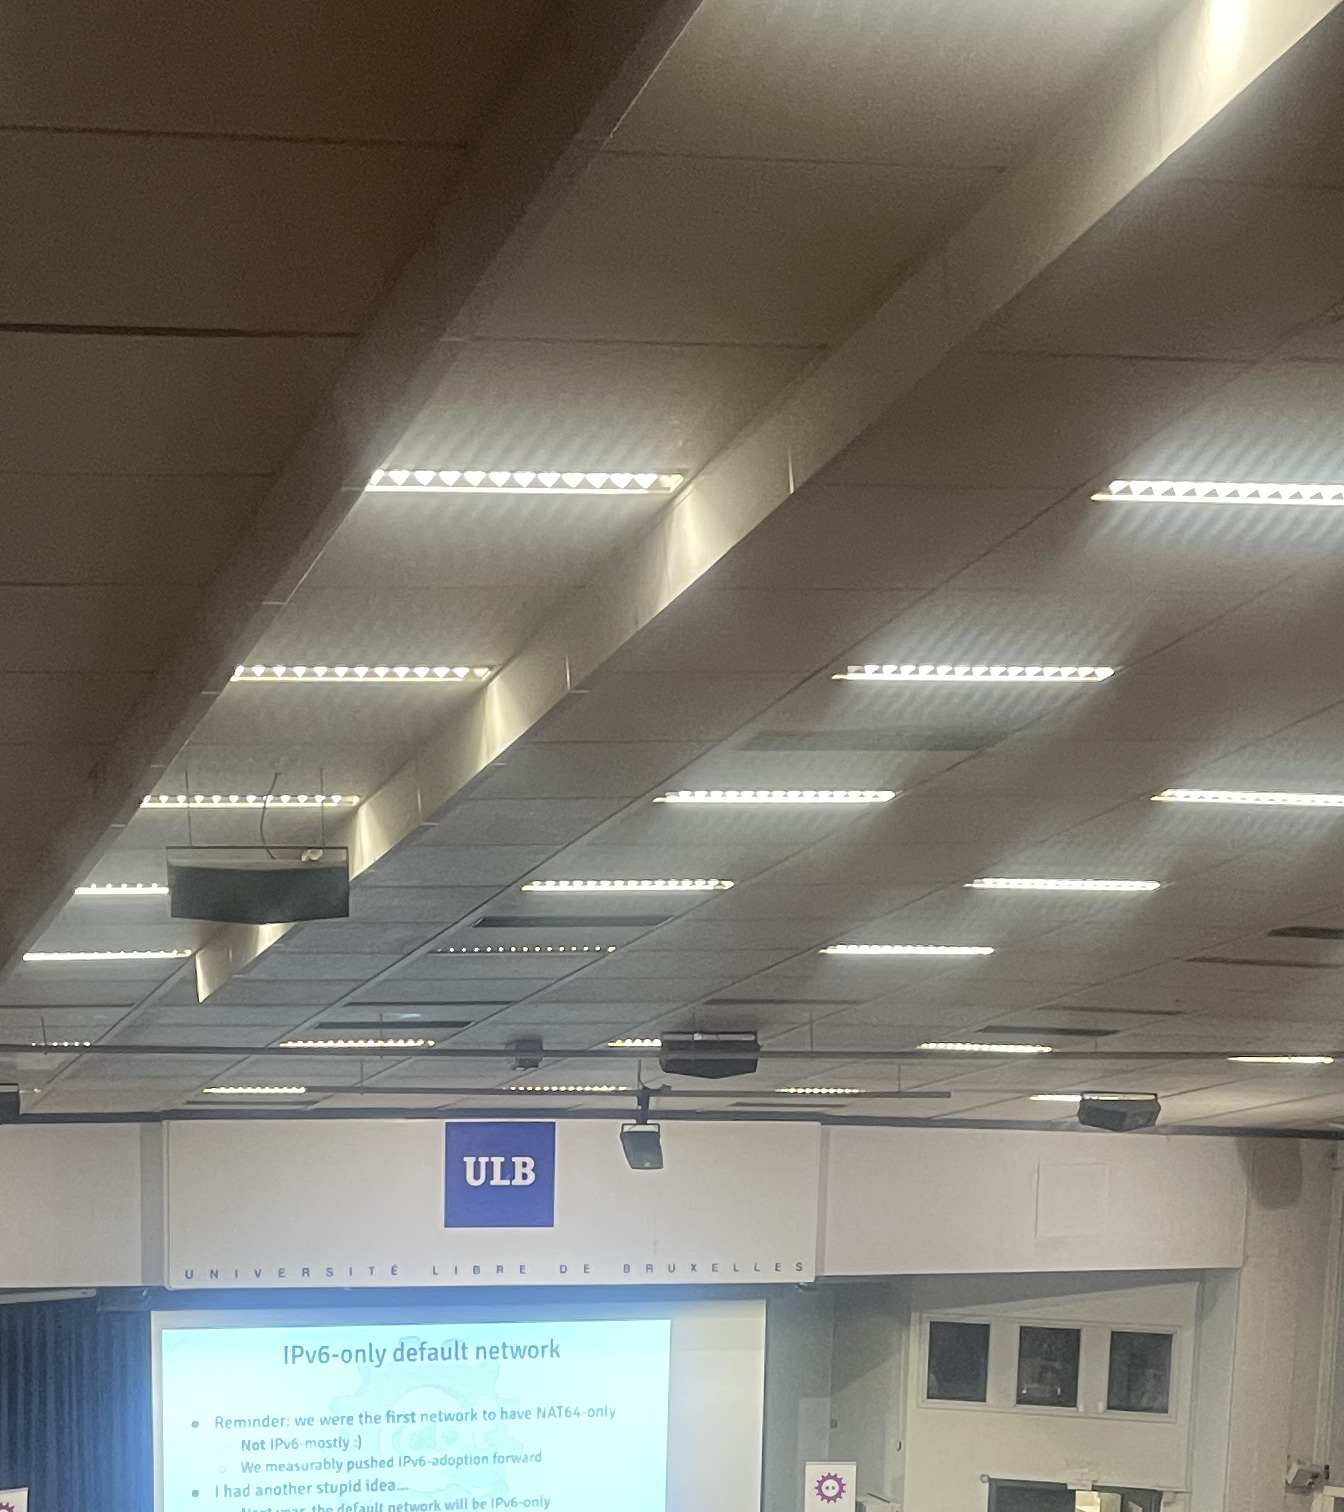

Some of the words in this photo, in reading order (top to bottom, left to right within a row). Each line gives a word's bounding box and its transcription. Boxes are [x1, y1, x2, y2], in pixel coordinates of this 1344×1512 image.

[463, 1156, 536, 1187] ULB
[184, 1264, 399, 1280] UNIVERSITÉ
[432, 1264, 528, 1276] LIBRE
[559, 1263, 592, 1275] DE
[623, 1261, 805, 1275] BRUXELLES
[284, 1342, 387, 1368] IPv6-only
[392, 1341, 469, 1363] default
[476, 1338, 561, 1361] network
[214, 1414, 290, 1429] Reminder:
[294, 1416, 315, 1427] we
[319, 1415, 354, 1426] were
[358, 1411, 382, 1425] the
[385, 1410, 416, 1424] first
[420, 1408, 478, 1423] network
[482, 1409, 496, 1421] to
[500, 1407, 532, 1420] have
[536, 1404, 616, 1420] NAT64-only
[241, 1438, 266, 1451] Not
[270, 1435, 350, 1451] IPv6-mostly
[241, 1461, 261, 1474] We
[265, 1457, 343, 1473] measurably
[347, 1456, 394, 1472] pushed
[398, 1453, 489, 1469] IPv6-adoption
[492, 1451, 542, 1465] forward
[215, 1485, 219, 1498] I
[224, 1483, 250, 1497] had
[255, 1481, 312, 1496] another
[316, 1479, 362, 1496] stupid
[444, 1497, 468, 1511] will
[472, 1497, 487, 1510] be
[491, 1495, 551, 1510] IPv6-only
